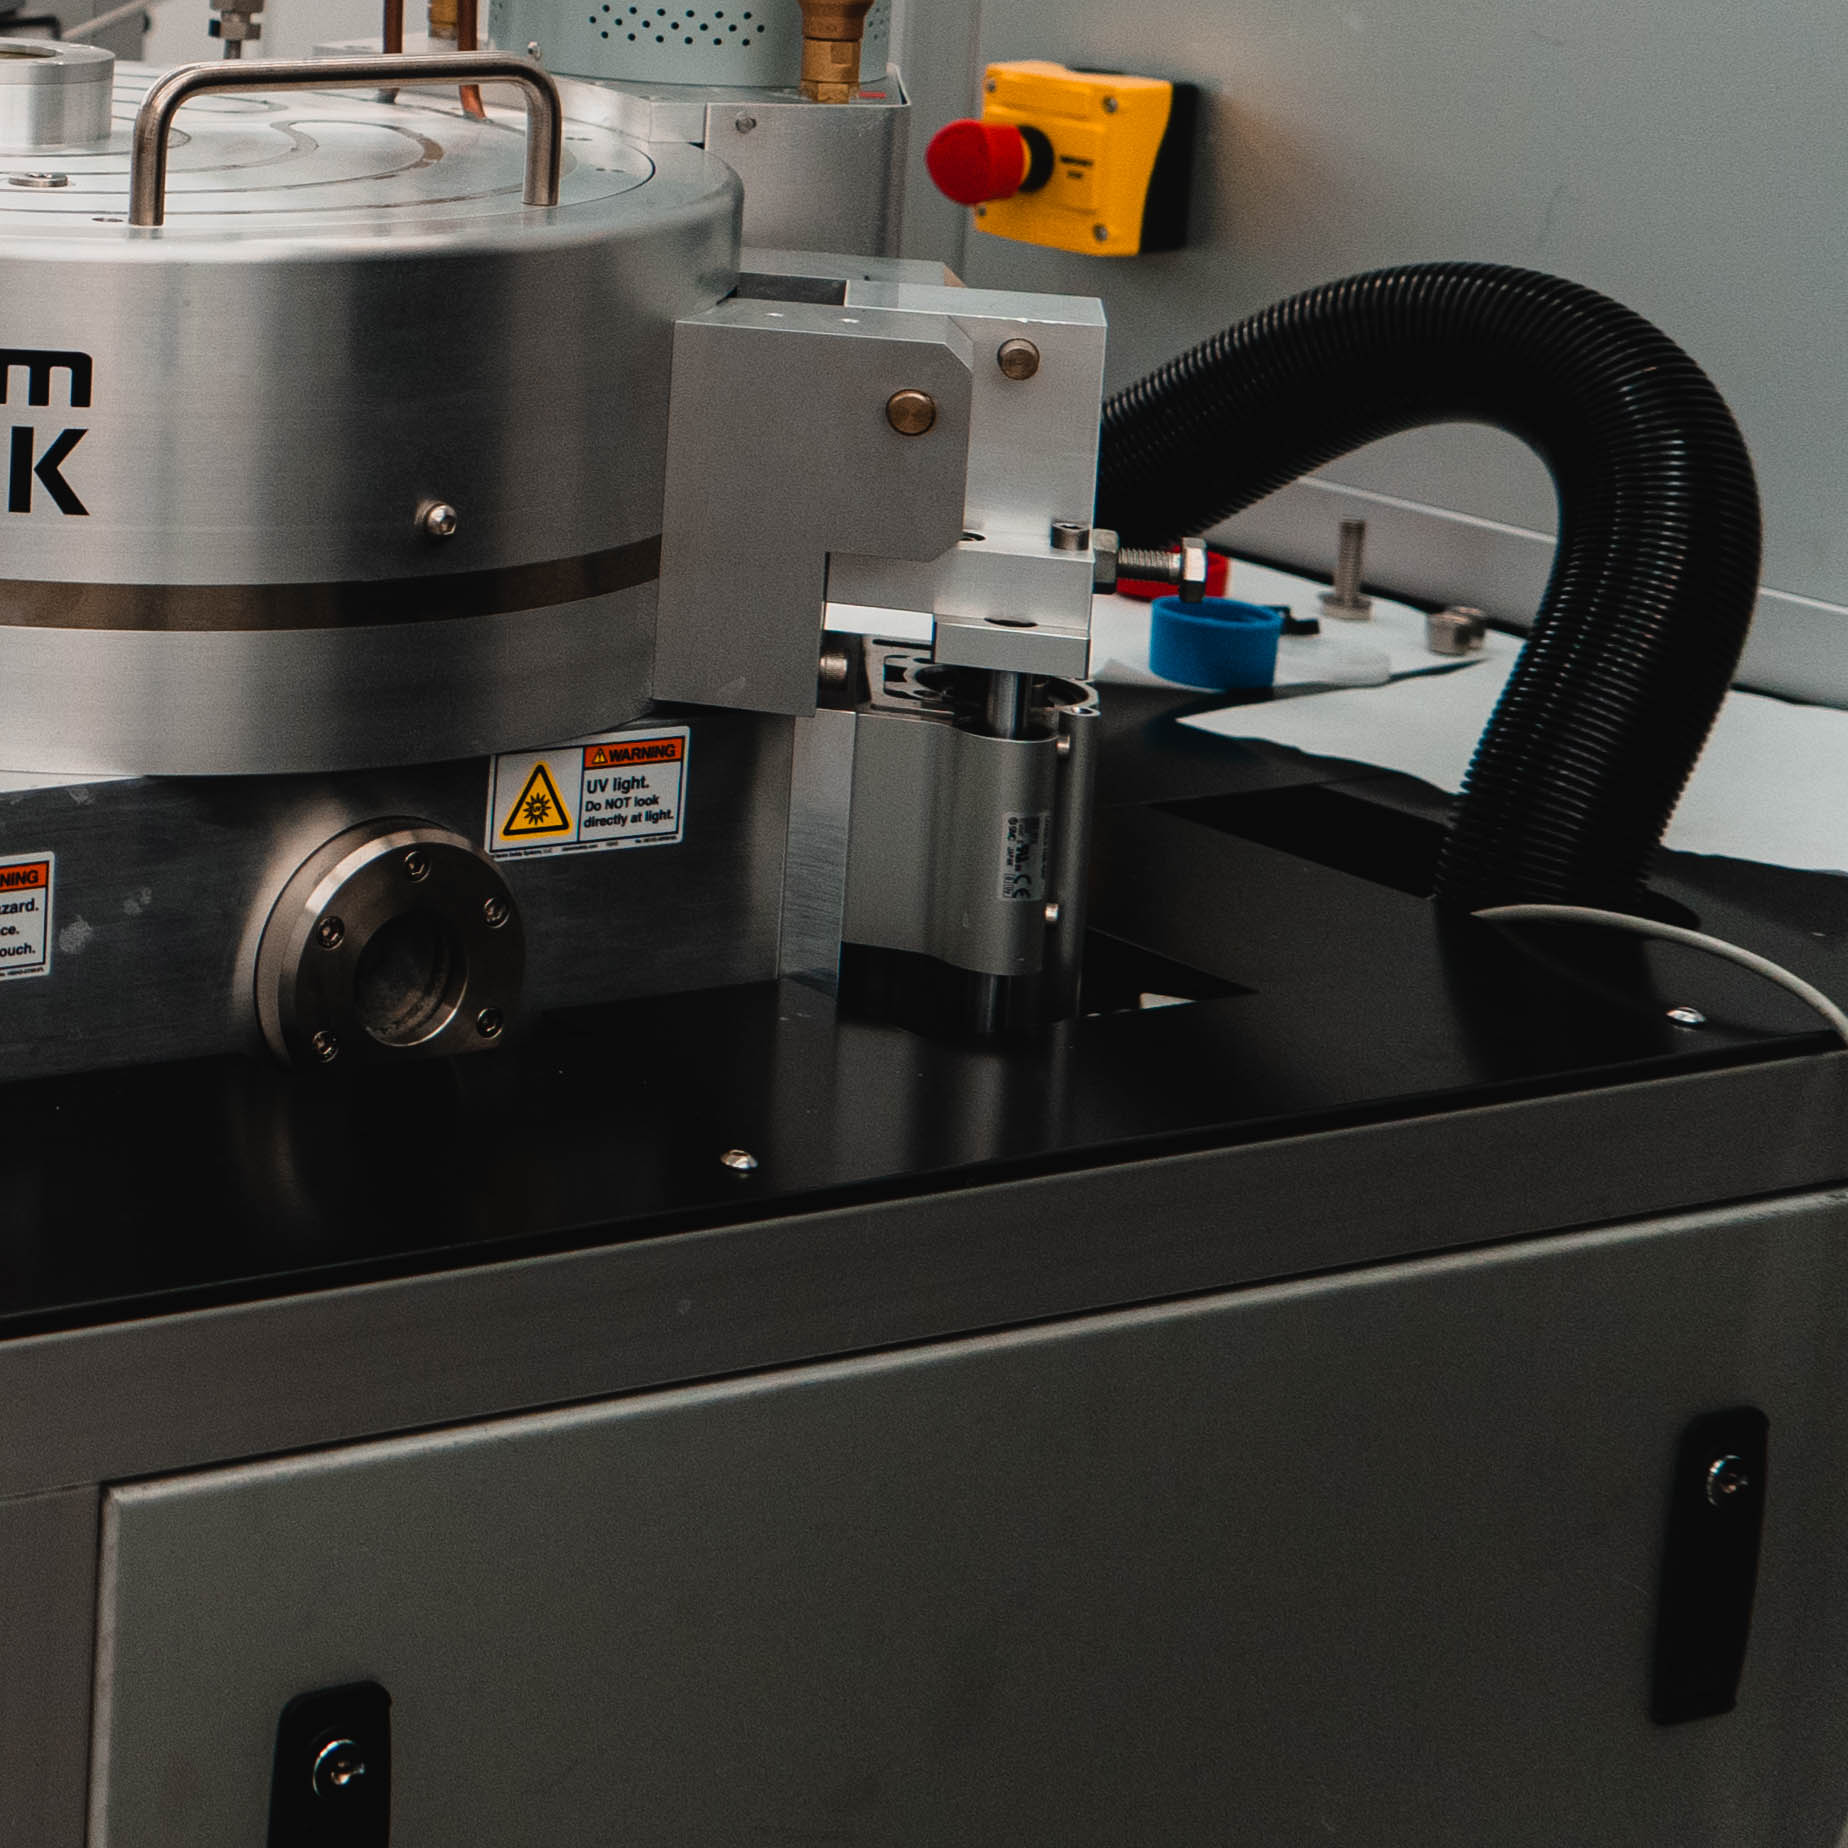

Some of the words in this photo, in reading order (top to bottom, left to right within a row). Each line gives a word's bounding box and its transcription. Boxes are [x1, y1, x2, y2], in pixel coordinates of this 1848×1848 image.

[609, 744, 675, 762] WARNING
[586, 779, 608, 794] UV
[612, 776, 649, 793] light.
[585, 800, 601, 812] Do
[604, 797, 631, 810] NOT
[634, 794, 659, 807] look
[583, 813, 628, 828] directly
[630, 814, 642, 823] at
[644, 809, 674, 825] light.
